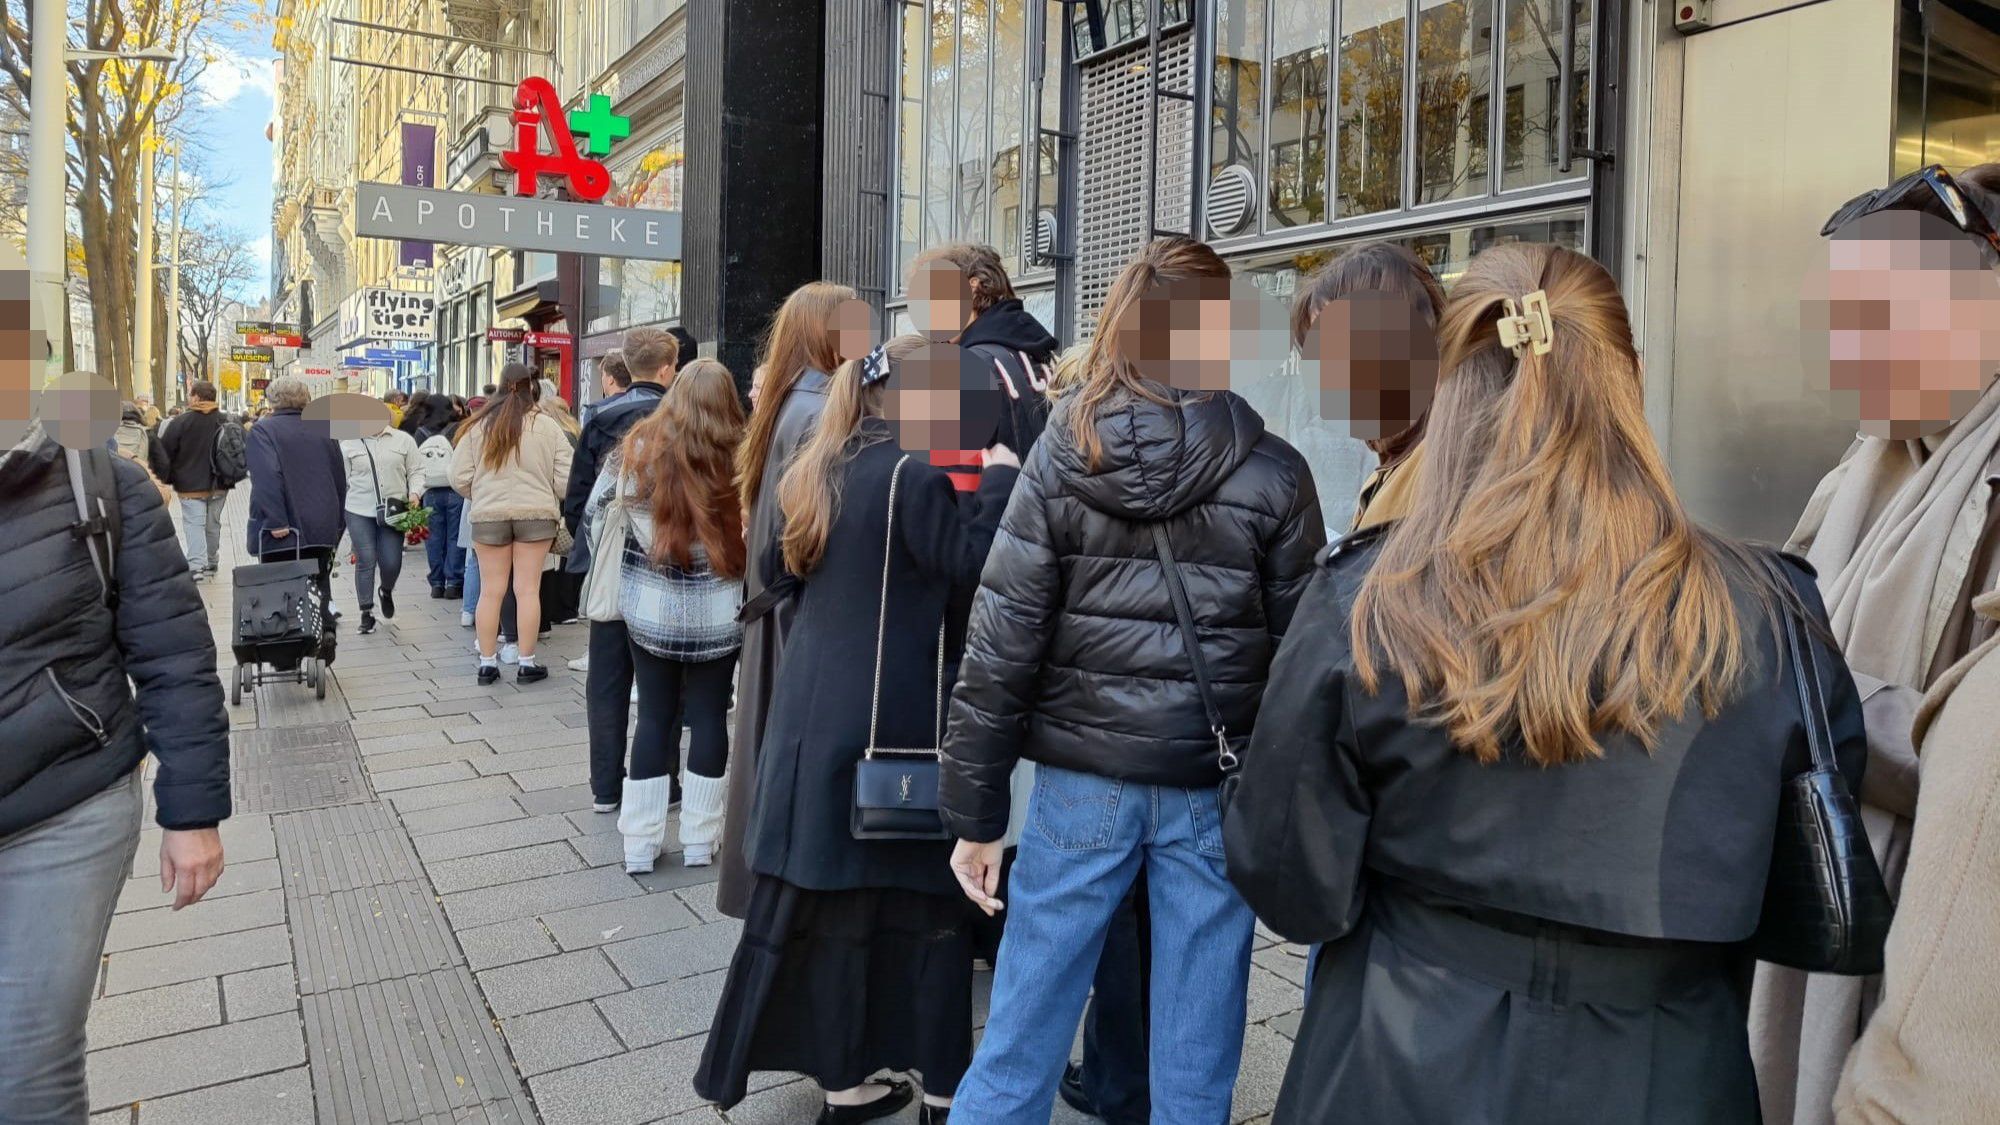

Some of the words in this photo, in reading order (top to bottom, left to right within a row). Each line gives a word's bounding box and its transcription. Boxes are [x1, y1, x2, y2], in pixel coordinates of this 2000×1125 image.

[371, 196, 660, 245] APOTHEKE
[369, 290, 434, 313] flying
[372, 309, 430, 329] tiger
[371, 329, 430, 339] copenhagen
[488, 330, 523, 339] AUTOMAT
